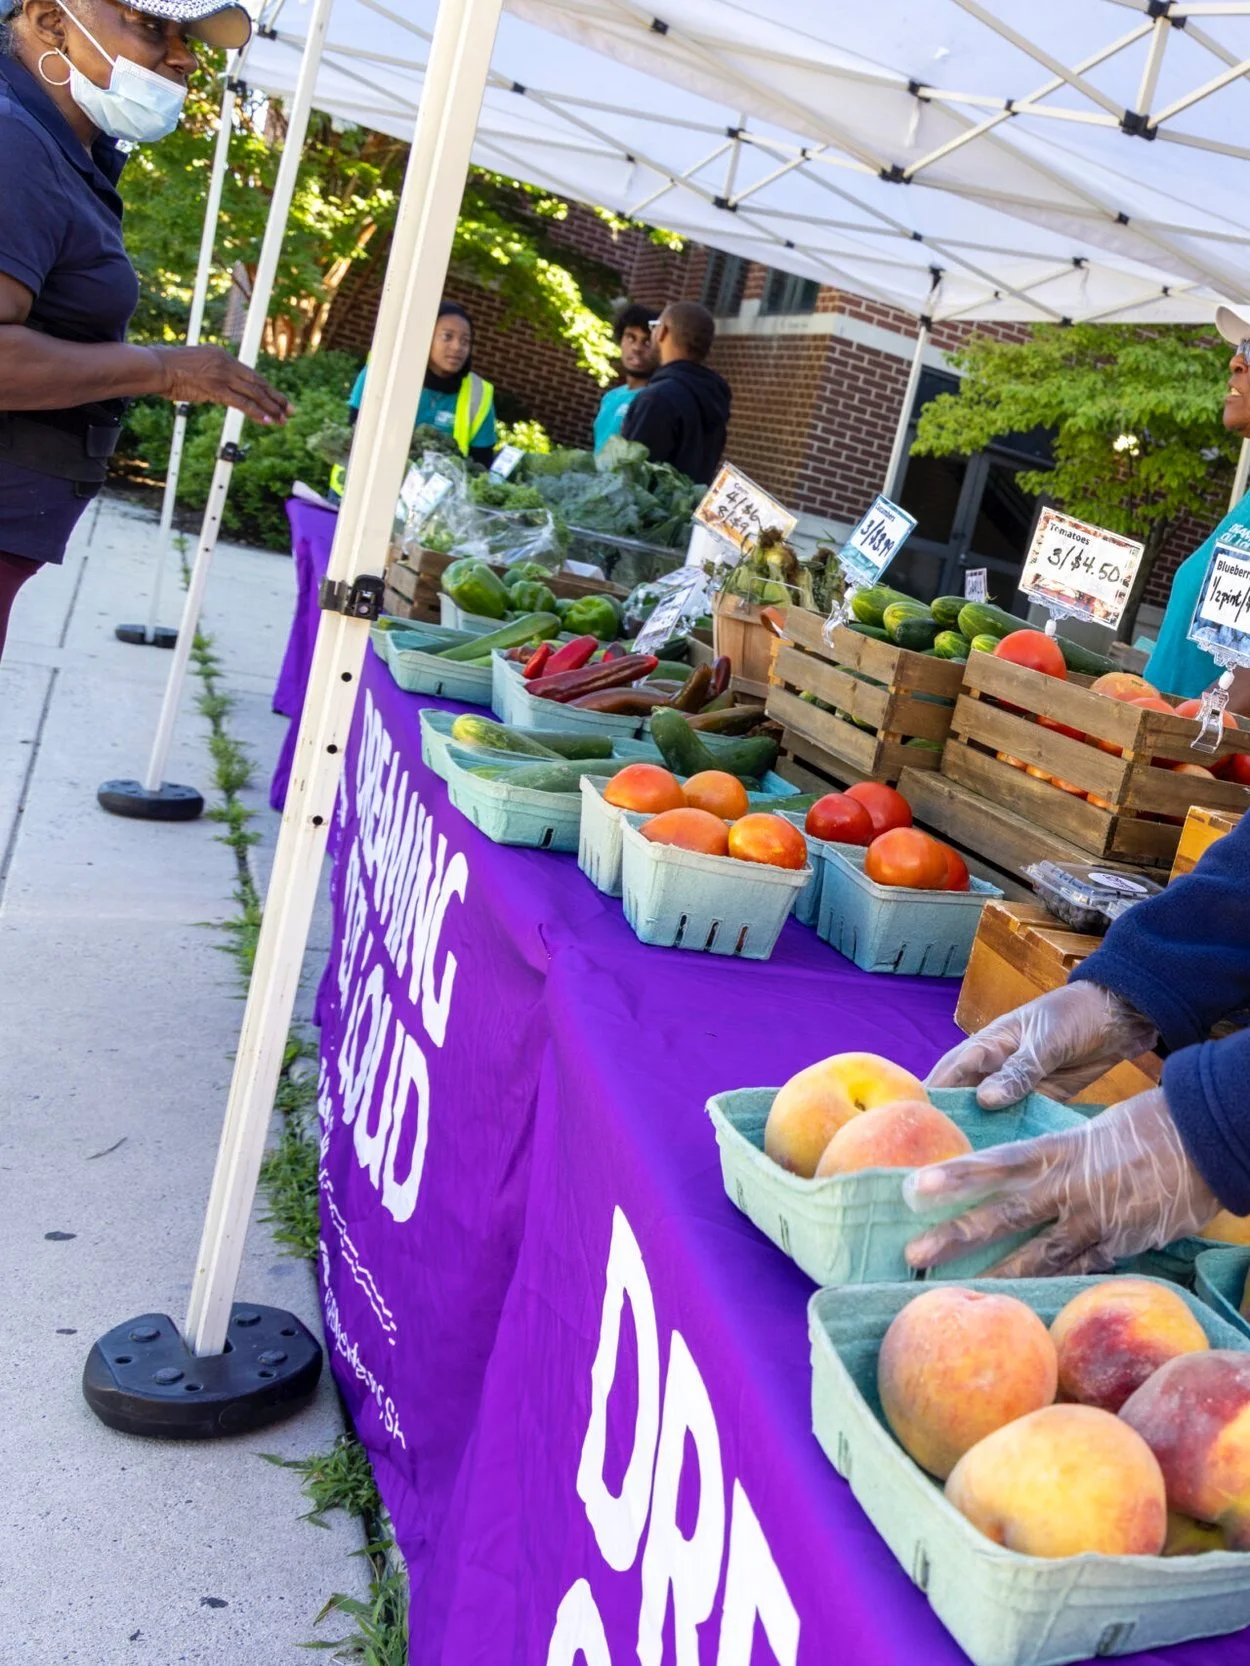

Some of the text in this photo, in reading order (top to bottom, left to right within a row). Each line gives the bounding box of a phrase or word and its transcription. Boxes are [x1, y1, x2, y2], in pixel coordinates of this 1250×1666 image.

[1049, 522, 1090, 545] Tomatoes
[1047, 546, 1120, 582] 3/$4.50
[355, 687, 469, 1048] DREAMING
